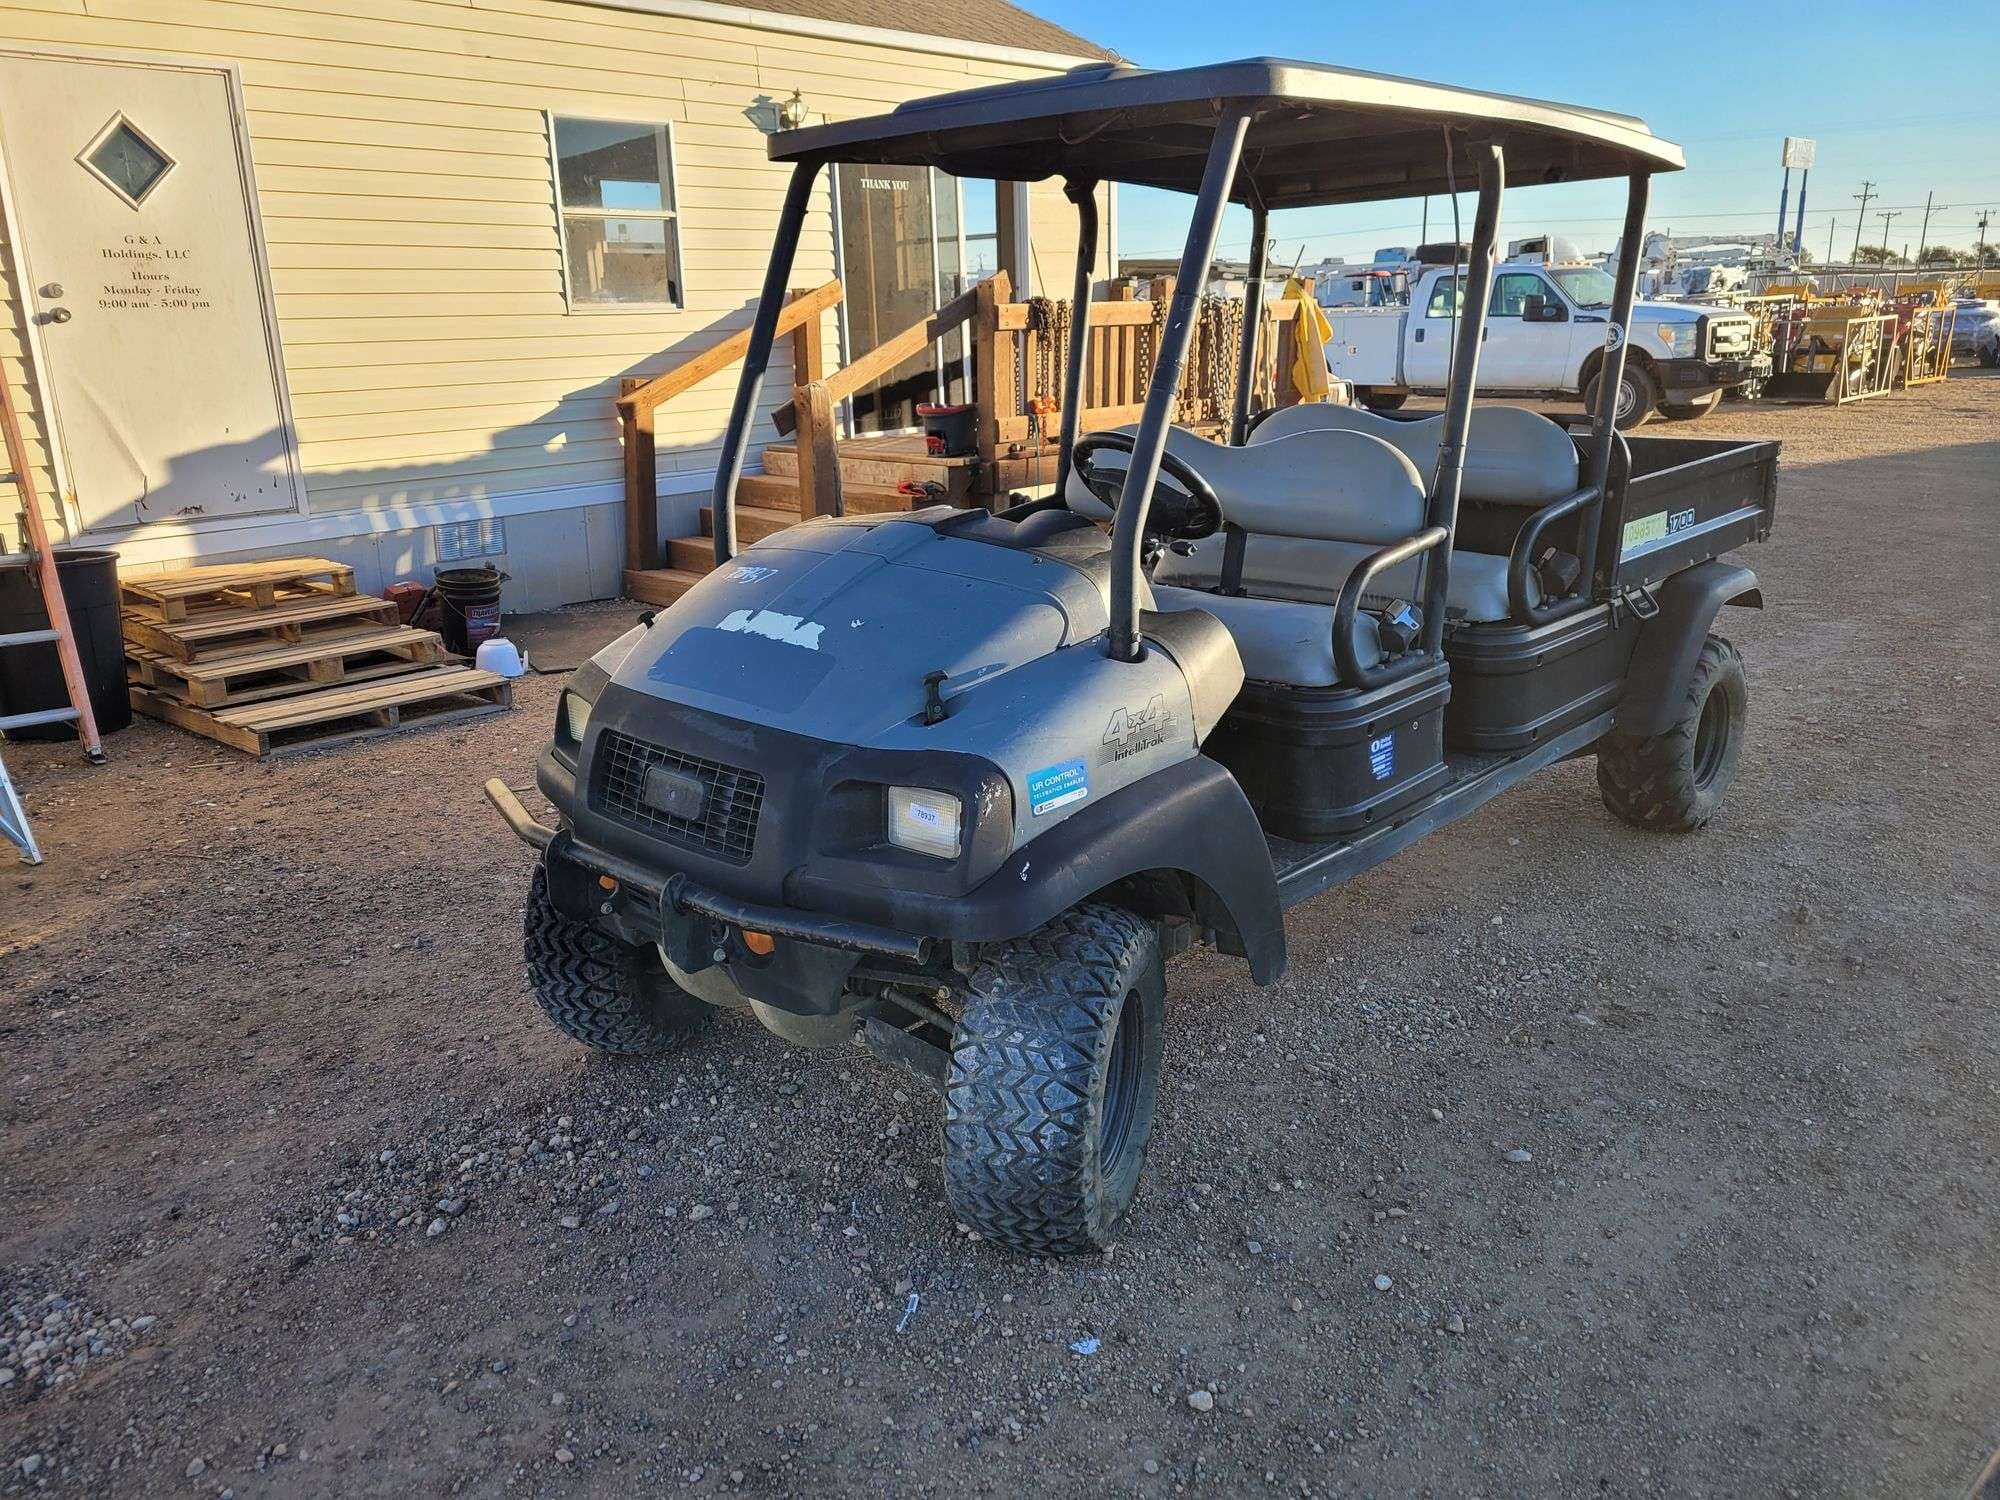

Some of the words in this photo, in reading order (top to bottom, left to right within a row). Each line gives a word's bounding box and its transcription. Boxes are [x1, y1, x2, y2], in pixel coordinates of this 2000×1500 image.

[860, 178, 891, 190] THANK
[891, 180, 910, 191] YOU
[124, 234, 134, 245] G
[139, 235, 148, 245] &
[152, 235, 162, 245] A
[166, 249, 191, 259] LLC
[131, 271, 170, 281] Hours
[103, 285, 152, 296] Monday
[164, 285, 201, 296] Friday
[98, 299, 127, 309] 9:00
[131, 301, 150, 309] am
[161, 298, 188, 309] 5:00
[191, 301, 210, 310] pm
[1102, 693, 1172, 747] 4x4
[1113, 733, 1165, 763] IntelliTrak
[1032, 780, 1044, 792] UR
[1044, 768, 1078, 787] CONTROL
